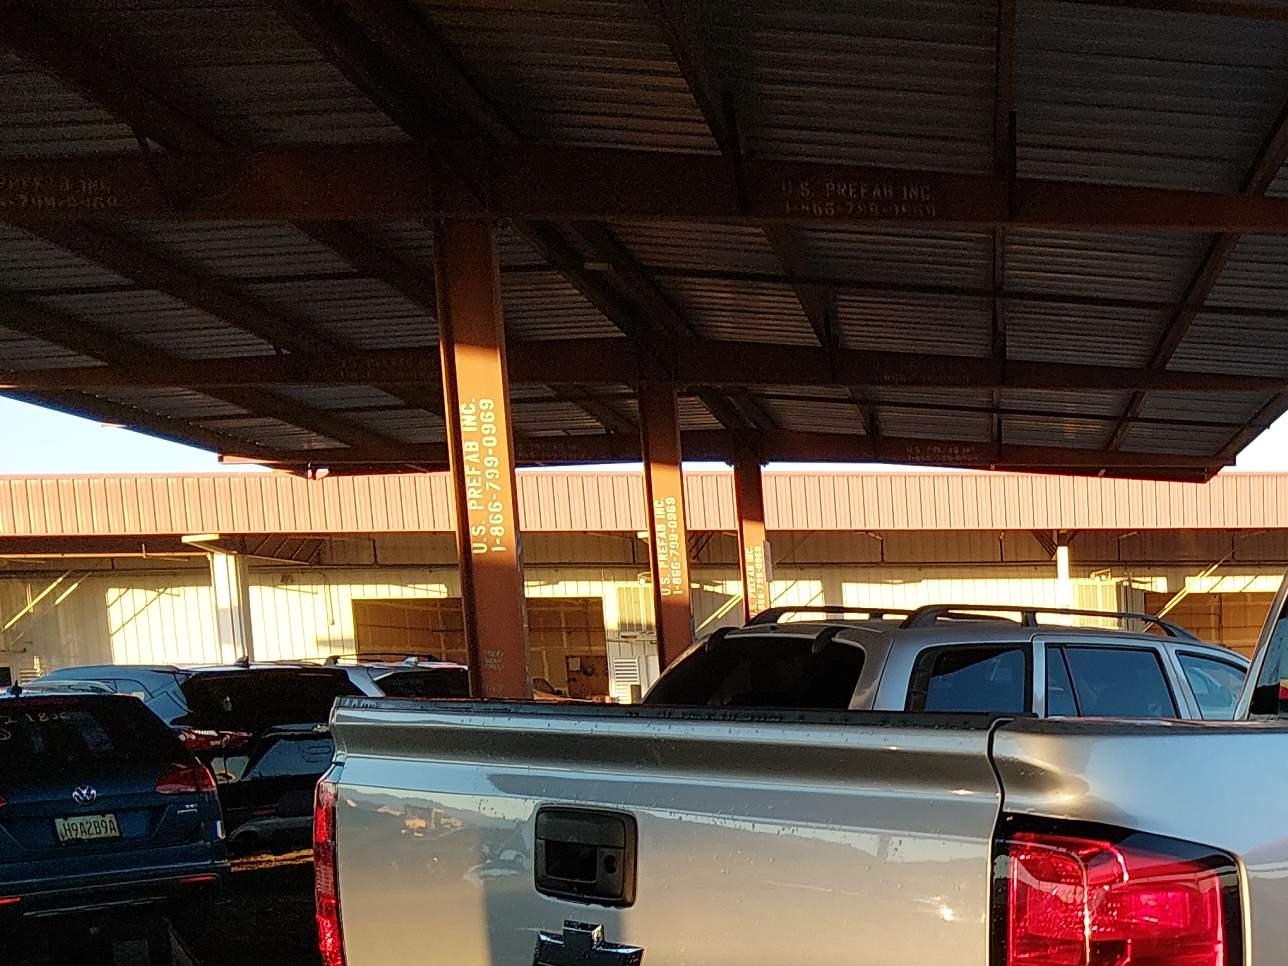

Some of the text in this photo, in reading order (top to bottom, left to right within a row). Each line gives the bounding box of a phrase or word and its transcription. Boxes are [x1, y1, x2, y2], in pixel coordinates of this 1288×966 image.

[825, 182, 894, 199] PREFAB
[461, 398, 488, 554] U.S. PREFAB INC.
[478, 398, 507, 552] 1-866-799-0969
[656, 523, 669, 569] PREFAB
[665, 497, 683, 595] 1-866-799-0969
[661, 573, 672, 596] U.S.
